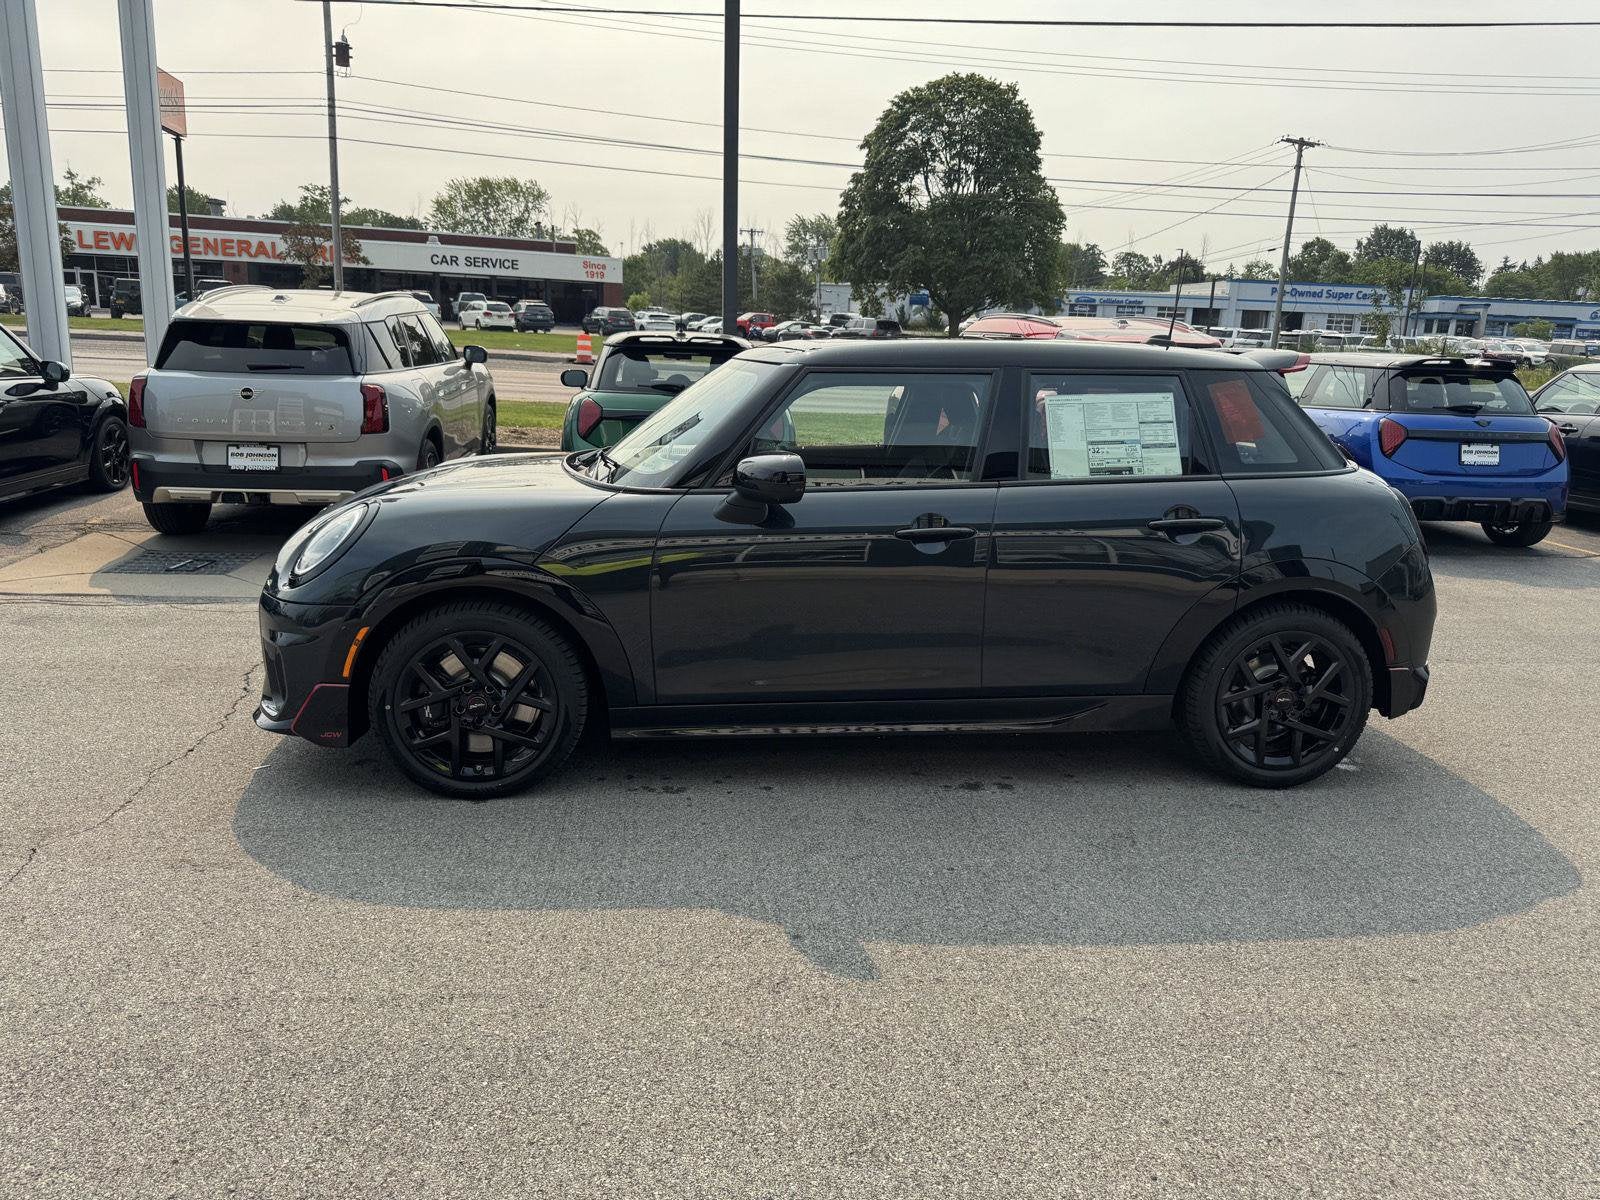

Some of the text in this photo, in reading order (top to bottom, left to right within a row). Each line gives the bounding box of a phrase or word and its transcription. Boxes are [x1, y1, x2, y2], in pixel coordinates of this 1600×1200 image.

[77, 229, 136, 251] LEW
[169, 235, 286, 260] GENERAL
[430, 253, 519, 271] CAR SERVICE
[582, 260, 607, 271] Since
[584, 270, 605, 280] 1919
[1325, 288, 1355, 301] Super
[176, 417, 322, 426] COUNTRYMAN
